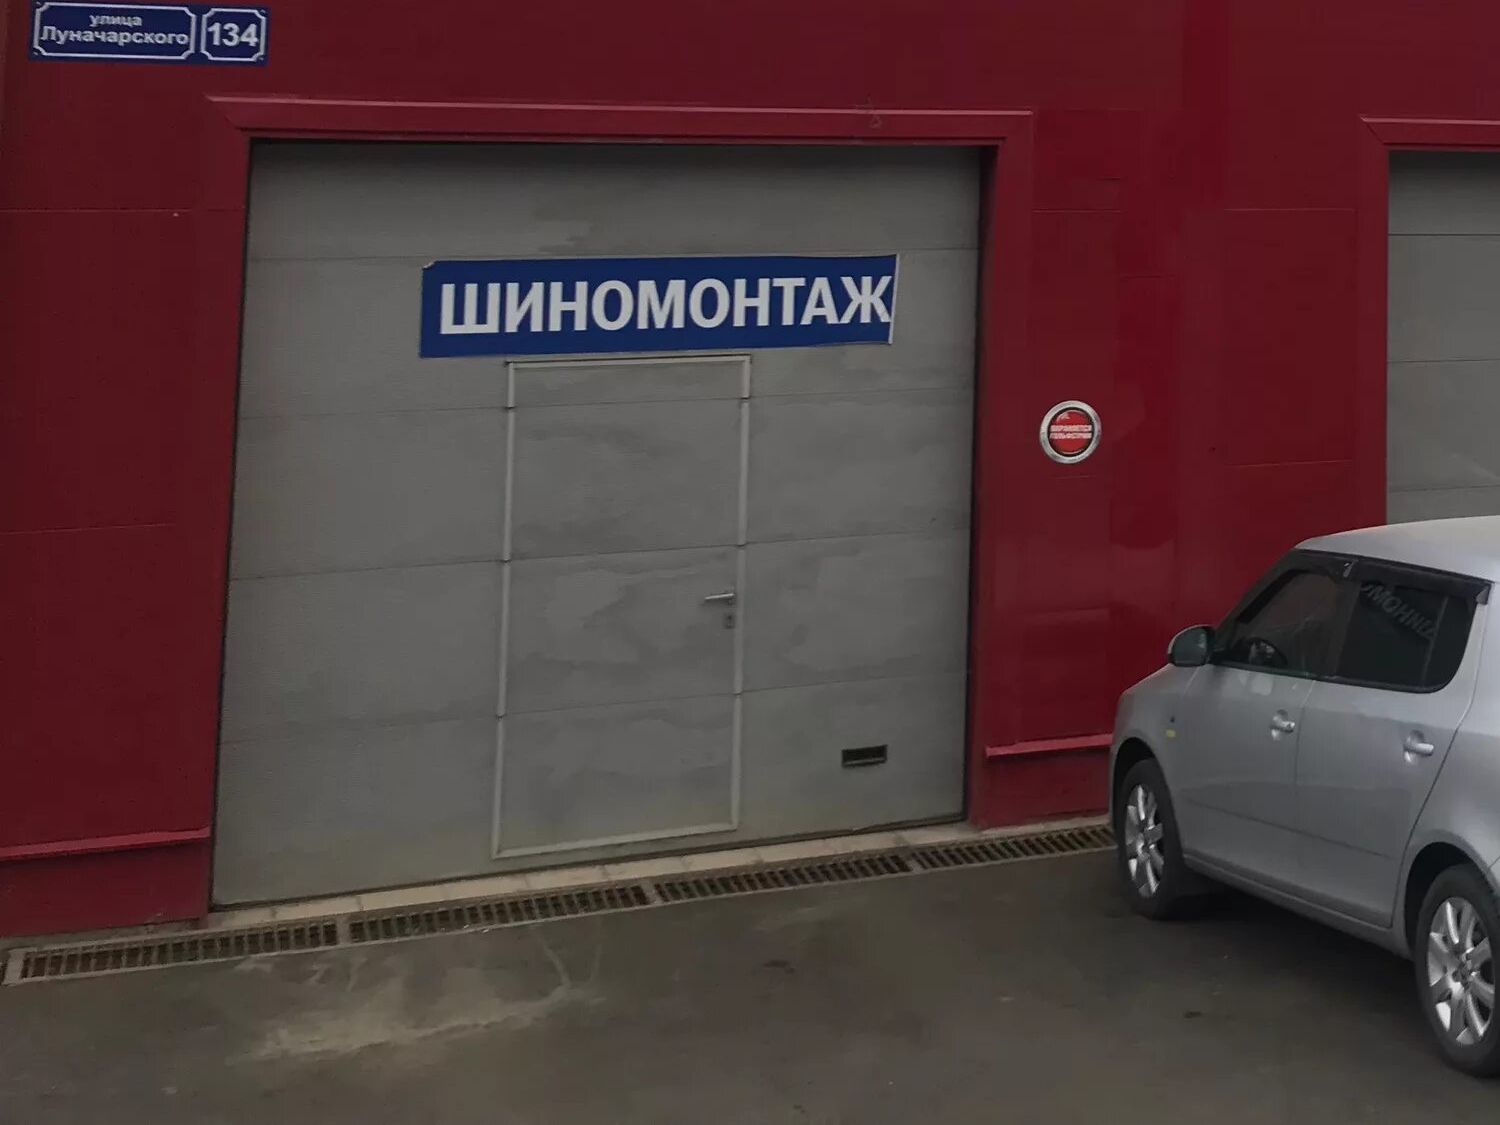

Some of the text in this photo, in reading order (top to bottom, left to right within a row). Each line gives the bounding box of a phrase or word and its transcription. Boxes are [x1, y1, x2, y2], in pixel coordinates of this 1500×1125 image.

[89, 14, 142, 27] улица
[40, 25, 189, 46] Луначарского
[207, 22, 259, 47] 134
[440, 275, 893, 335] ШИНОМОНТАЖ
